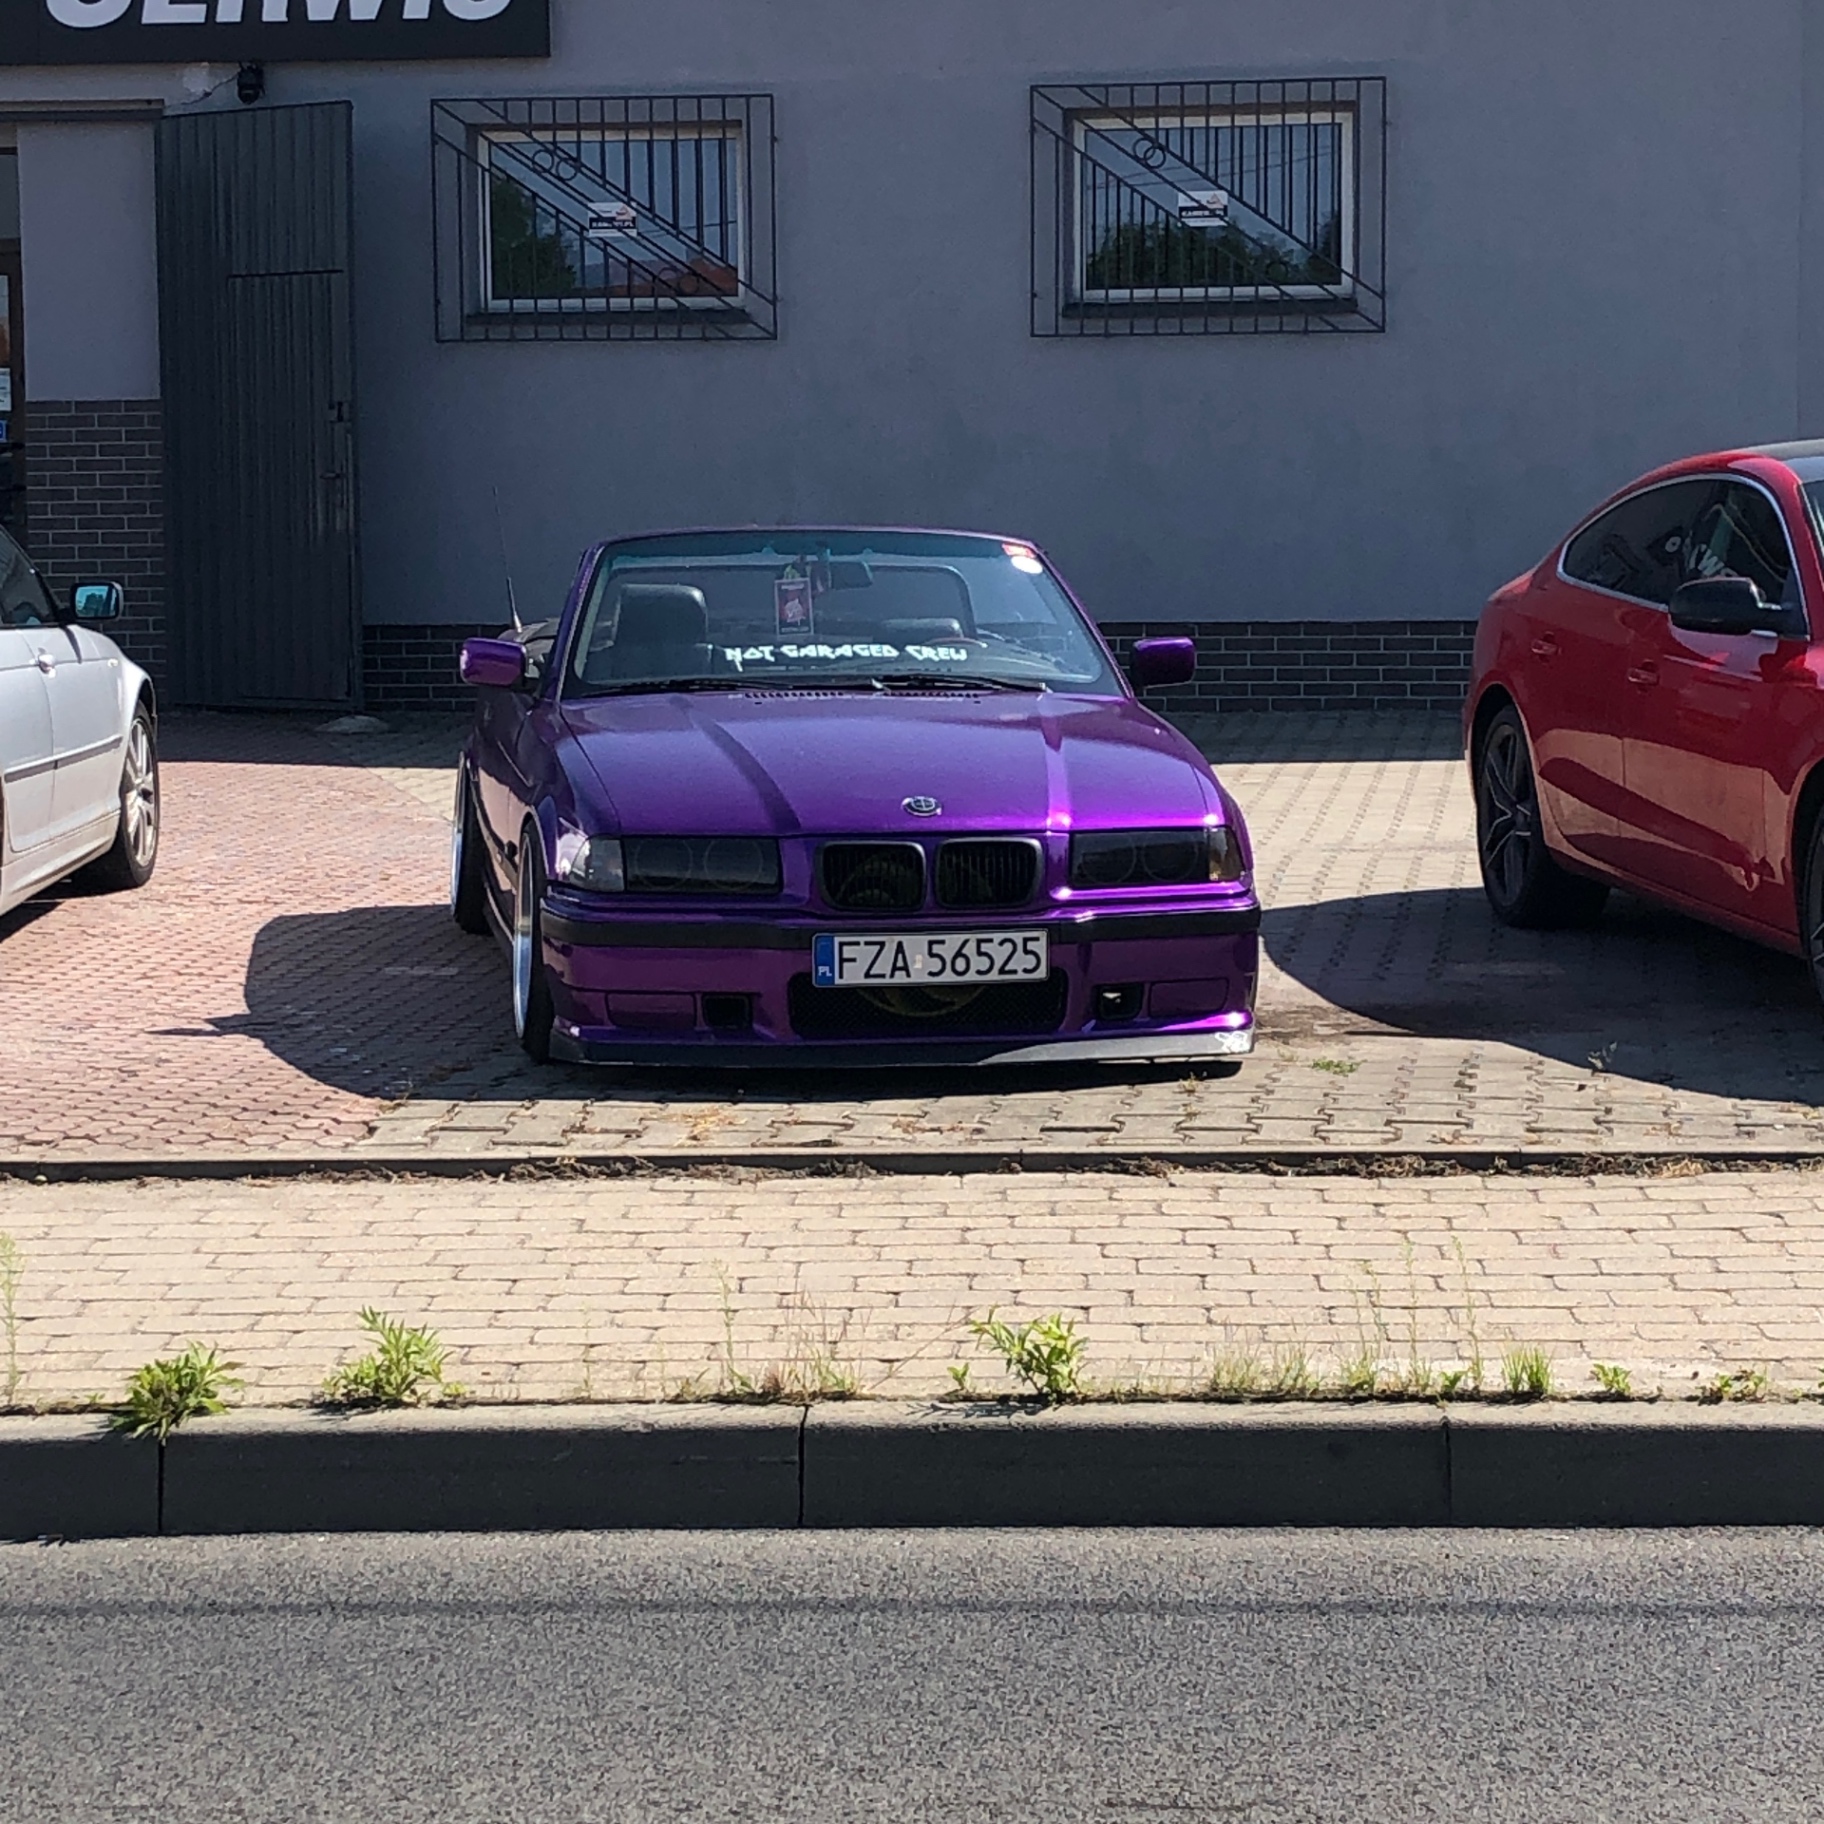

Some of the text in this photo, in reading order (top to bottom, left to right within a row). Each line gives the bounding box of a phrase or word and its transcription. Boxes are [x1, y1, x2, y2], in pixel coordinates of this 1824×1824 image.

[724, 645, 968, 672] NOT GARAGED CREW
[818, 966, 832, 976] PL
[838, 937, 1041, 979] FZA 56525
